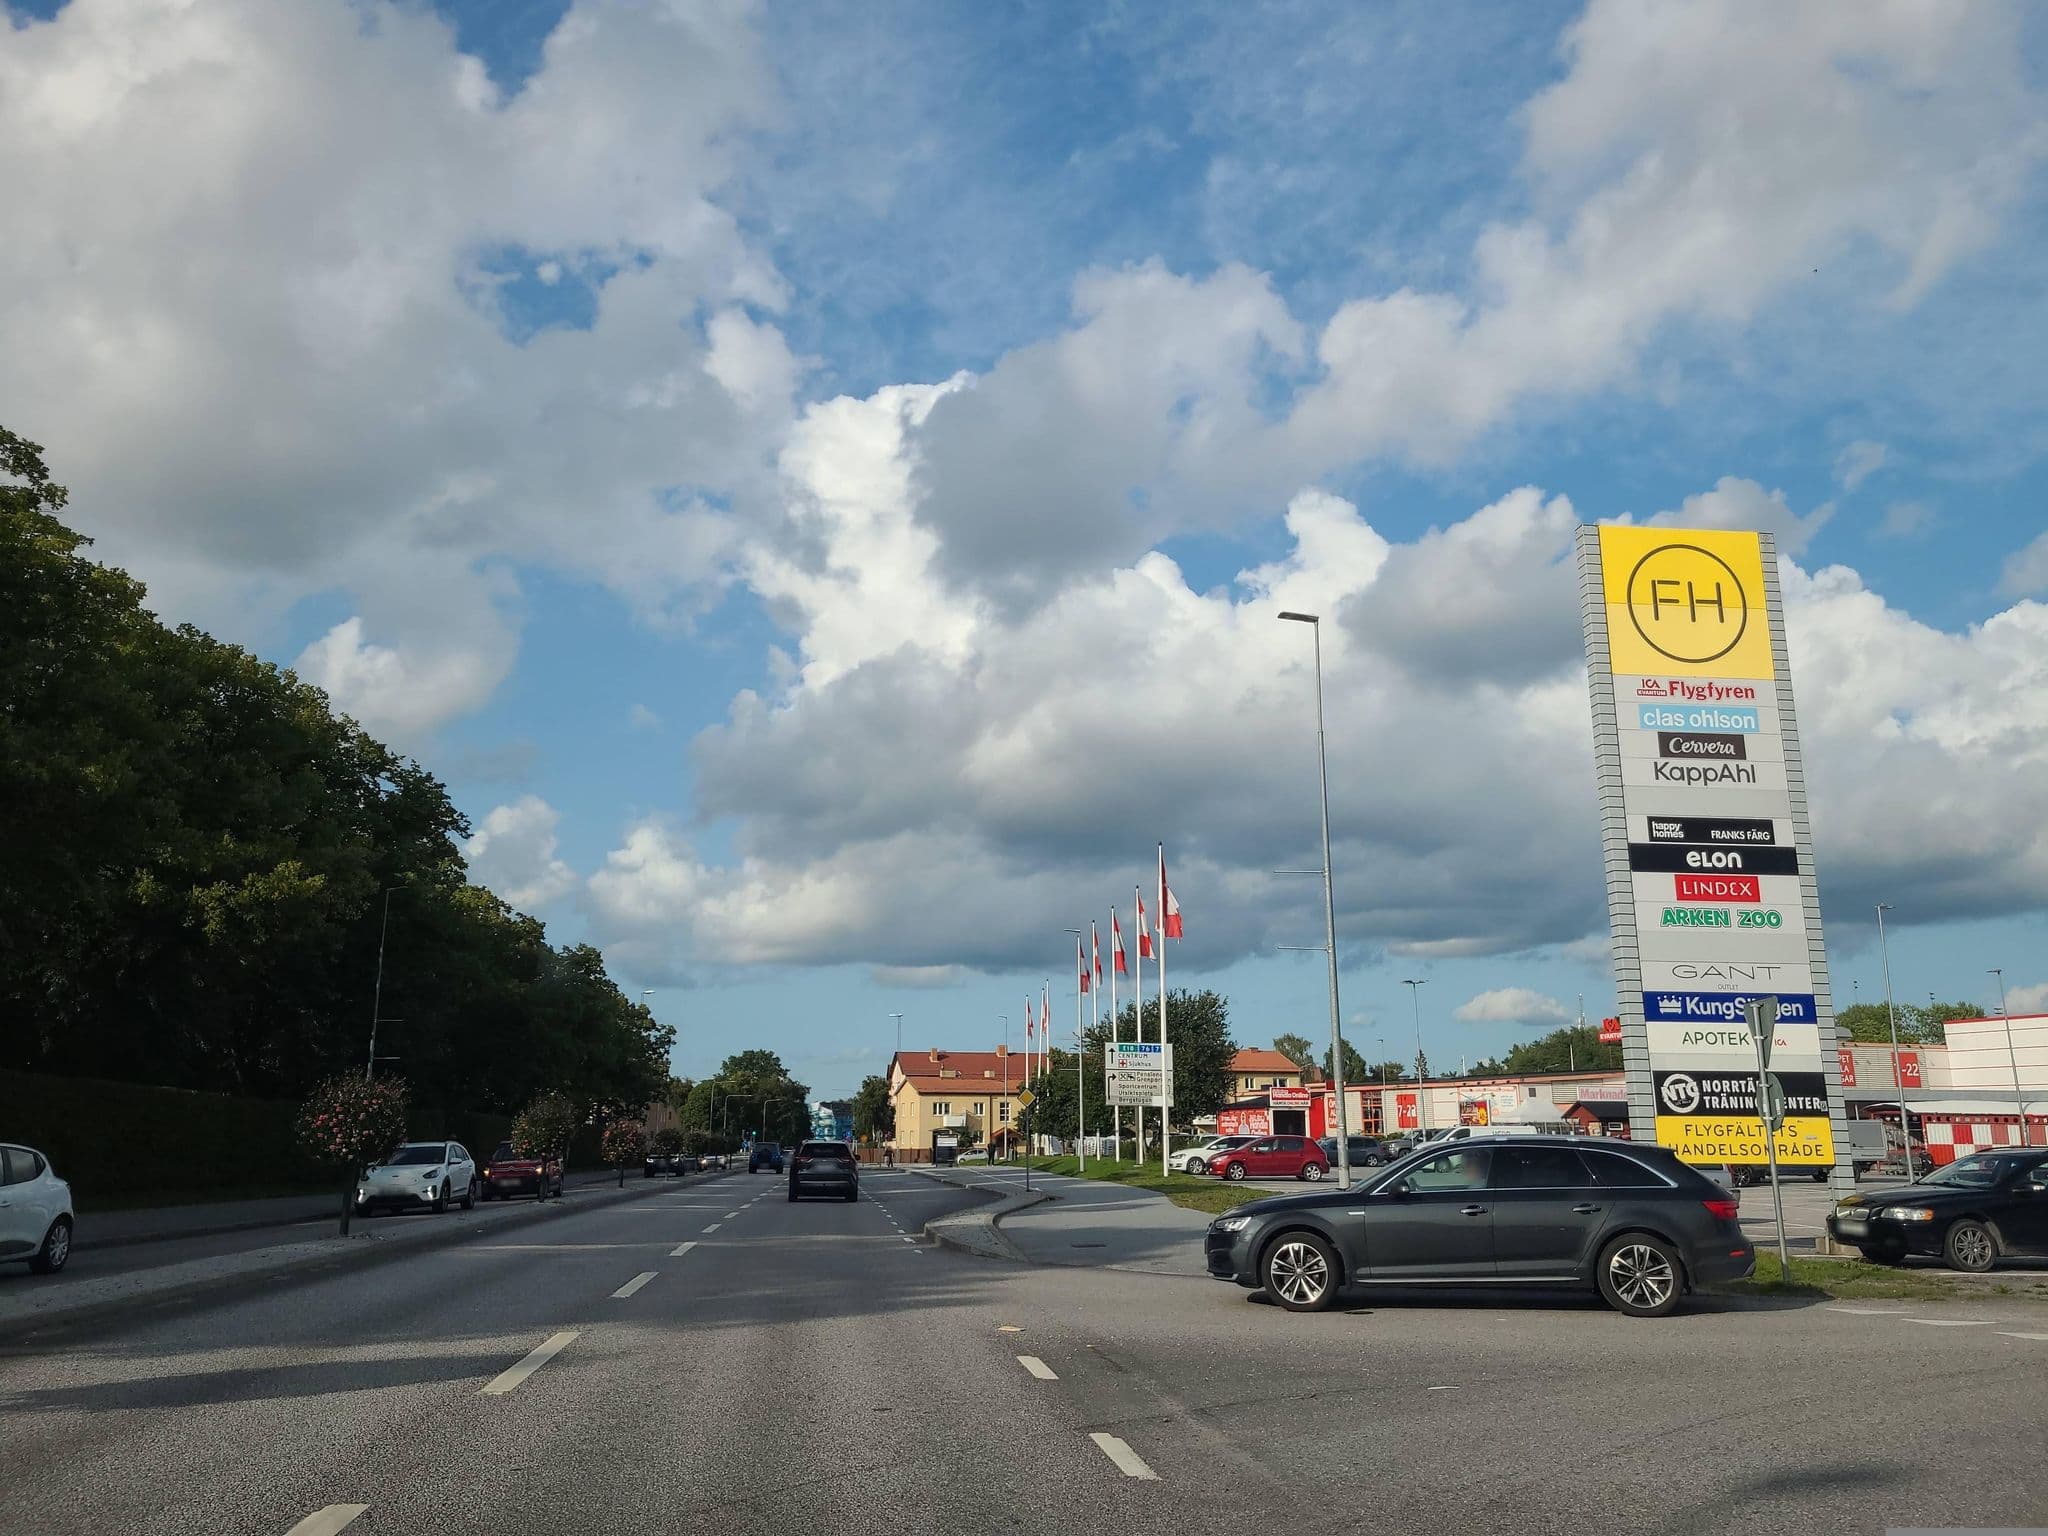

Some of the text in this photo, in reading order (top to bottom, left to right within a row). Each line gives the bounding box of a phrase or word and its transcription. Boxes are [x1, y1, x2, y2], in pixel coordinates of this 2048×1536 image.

[1651, 579, 1724, 623] FH
[1642, 679, 1660, 689] ICA
[1669, 681, 1755, 700] Flygfyren
[1643, 708, 1755, 729] clas ohlson
[1669, 737, 1736, 755] Cervera
[1654, 761, 1756, 786] KappAhl
[1652, 821, 1680, 831] happy
[1653, 829, 1684, 839] homes
[1711, 828, 1769, 841] FRANKS FÄRG
[1682, 880, 1752, 896] LINDEX
[1660, 907, 1783, 929] ARKEN ZOO
[1672, 964, 1781, 980] GANT
[1682, 1032, 1787, 1047] APOTEK ICA
[1685, 1121, 1798, 1137] FLYGFÄLTTS
